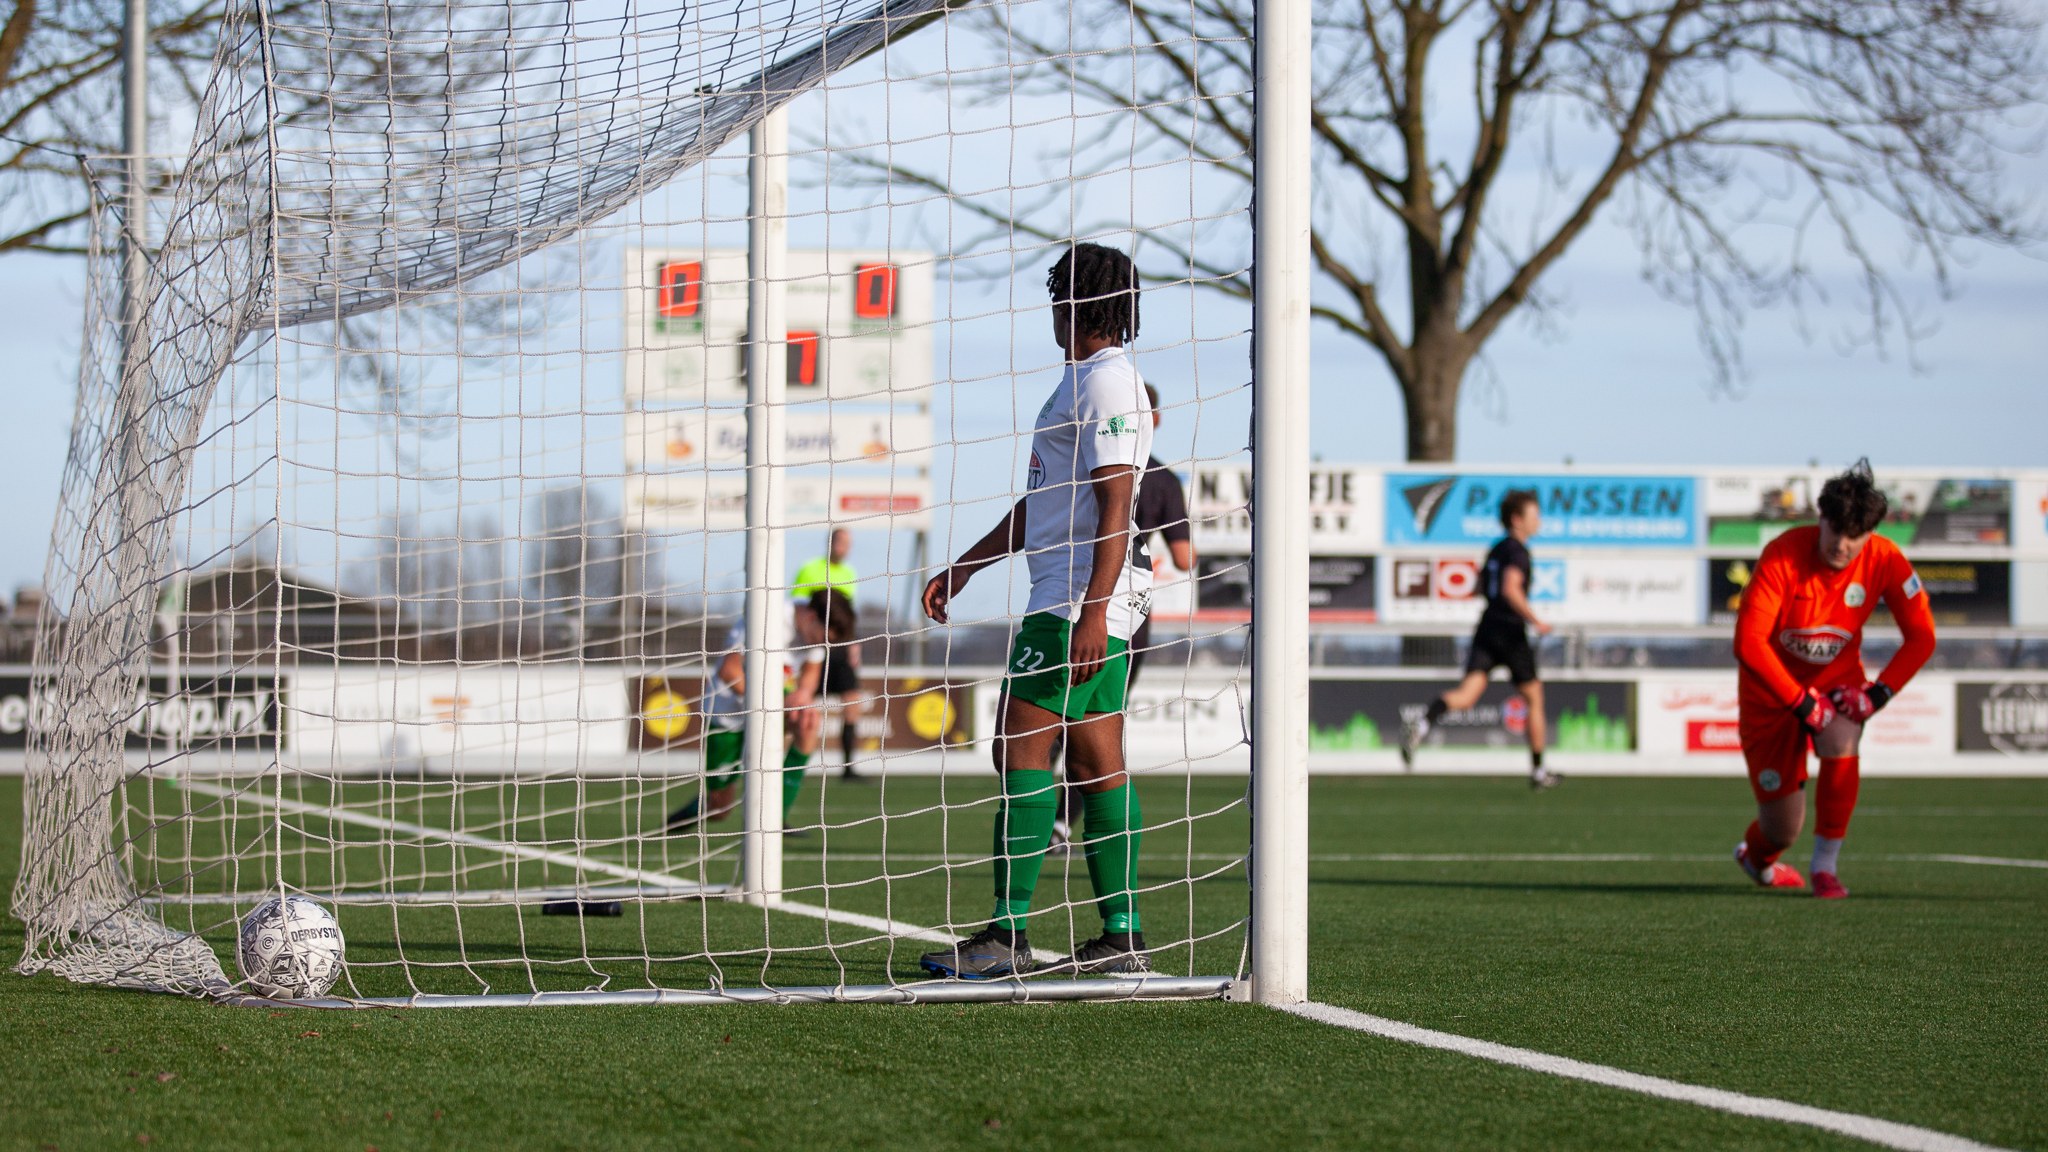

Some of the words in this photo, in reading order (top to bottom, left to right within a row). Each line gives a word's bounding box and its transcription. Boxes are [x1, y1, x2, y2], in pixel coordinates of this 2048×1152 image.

[659, 261, 701, 317] 0
[855, 263, 898, 318] 0
[1394, 561, 1567, 601] FOX
[1016, 646, 1044, 672] 22
[1785, 636, 1847, 658] ZWAR
[290, 927, 338, 943] DERBYSTA
